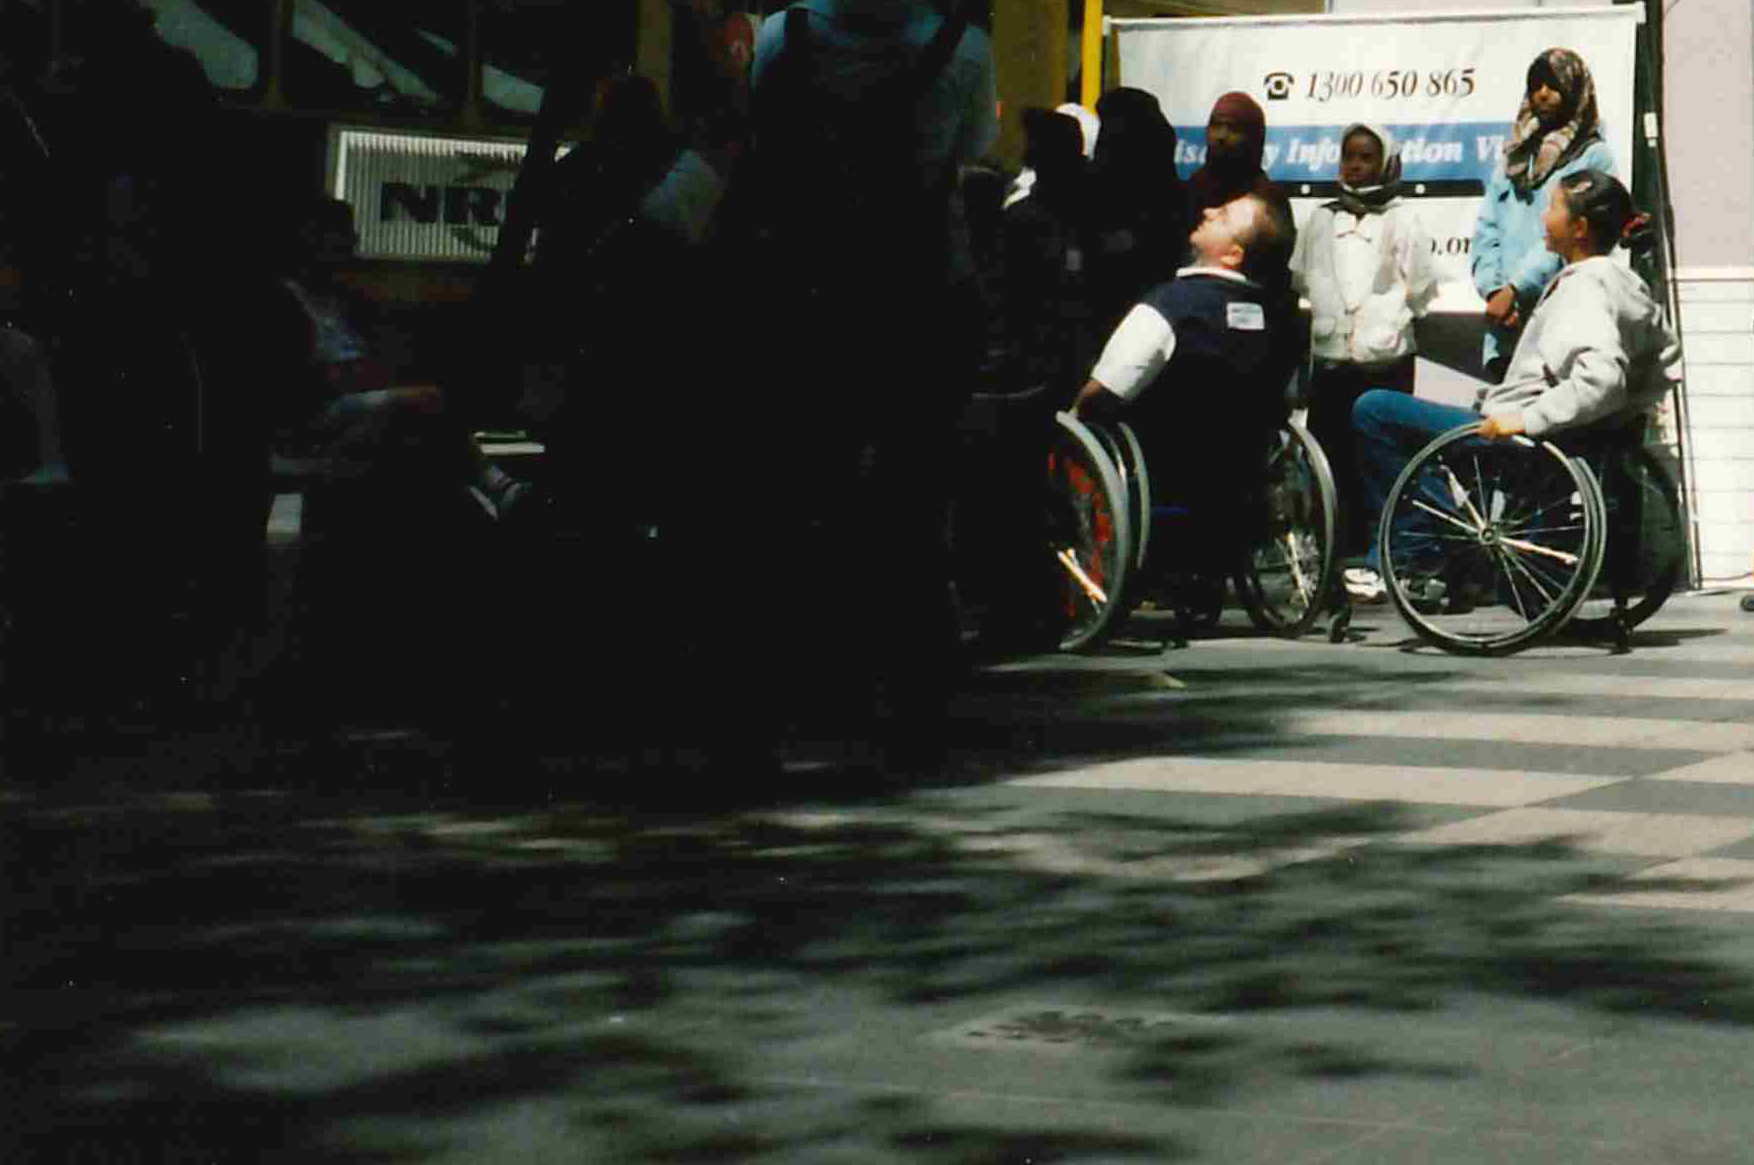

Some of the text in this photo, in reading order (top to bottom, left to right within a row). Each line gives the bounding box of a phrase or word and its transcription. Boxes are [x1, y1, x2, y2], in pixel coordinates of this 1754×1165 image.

[1307, 67, 1475, 103] 1300 650 865
[381, 182, 516, 224] NR
